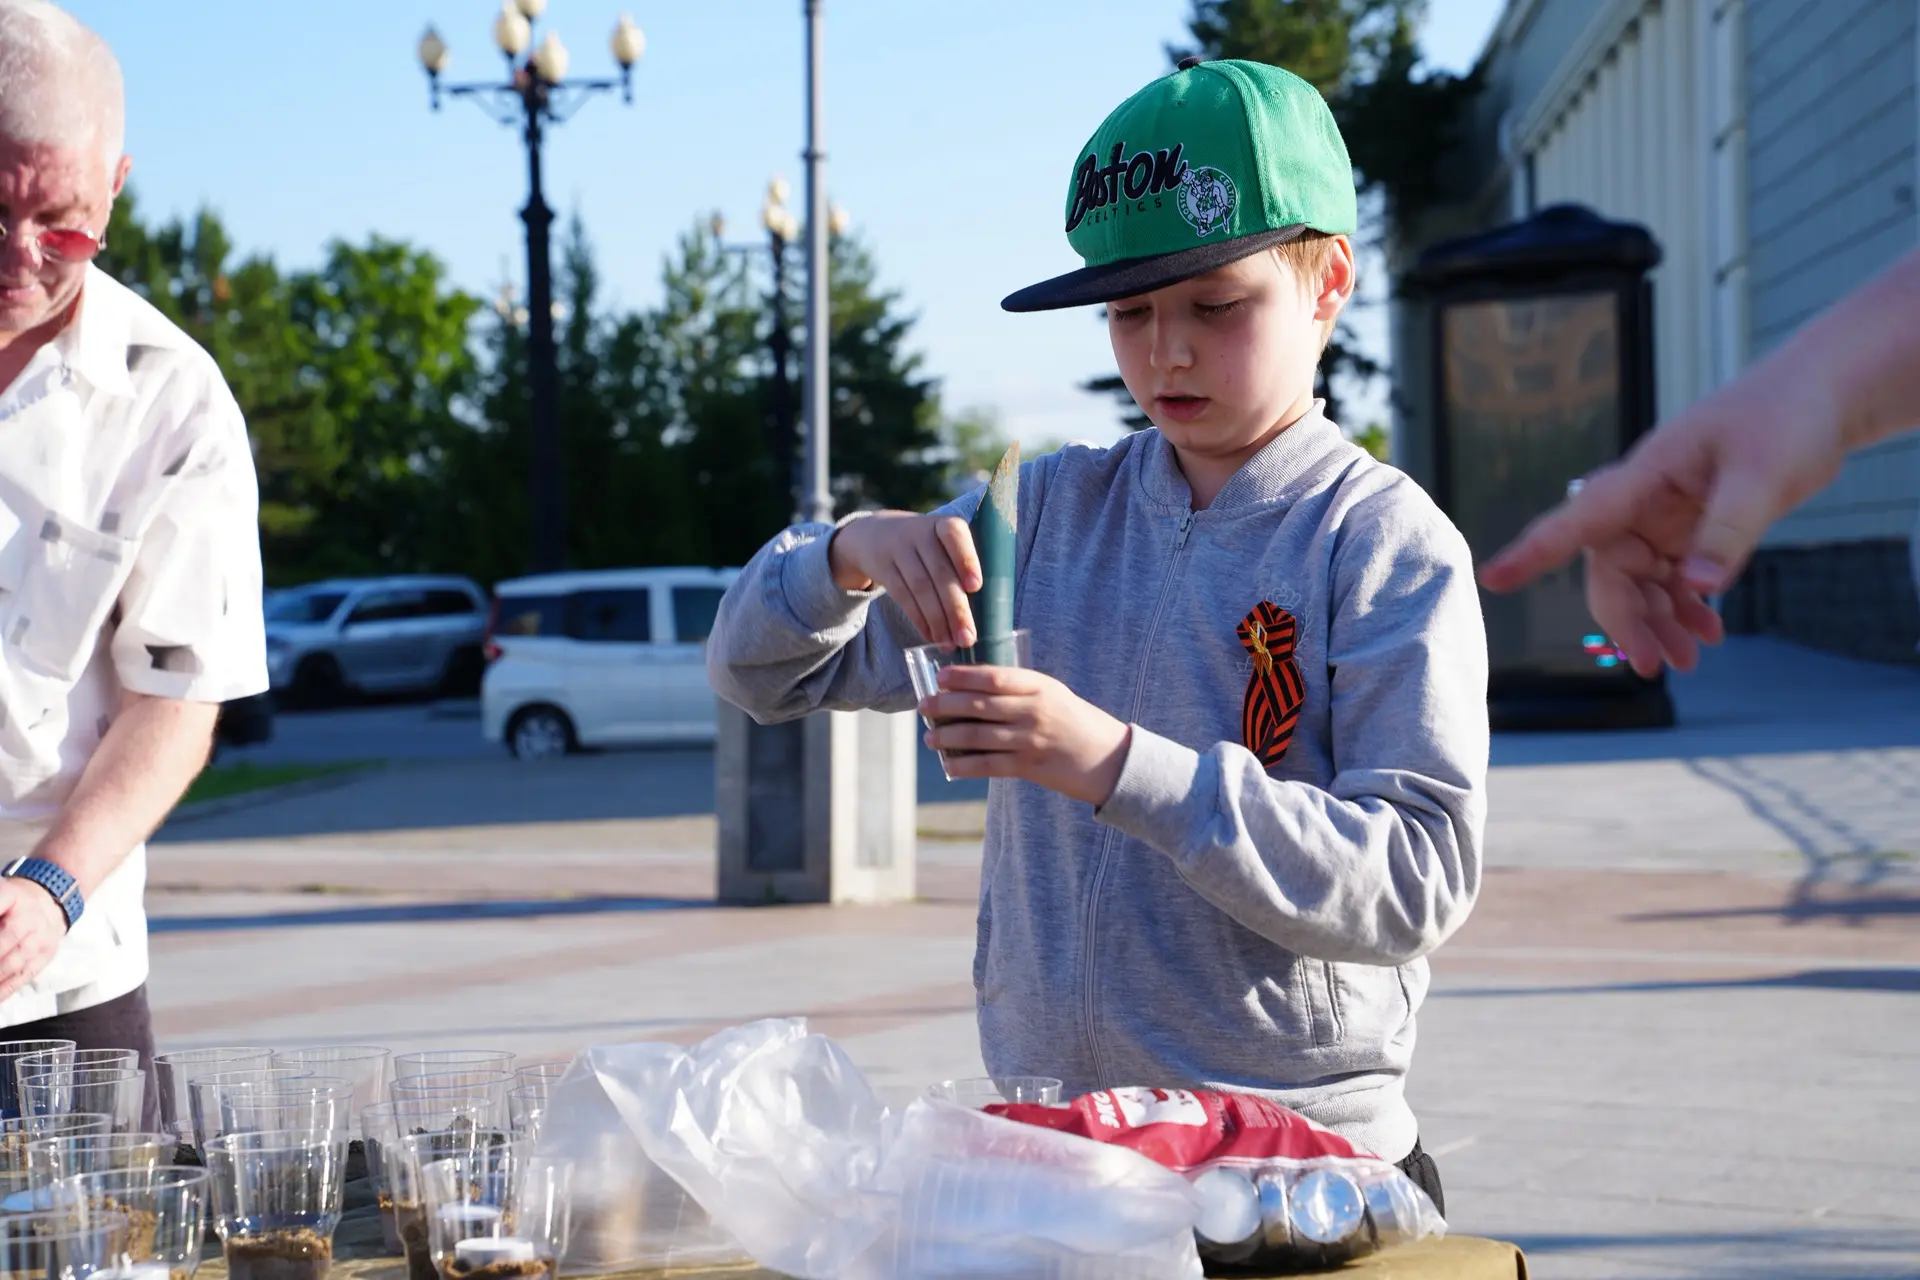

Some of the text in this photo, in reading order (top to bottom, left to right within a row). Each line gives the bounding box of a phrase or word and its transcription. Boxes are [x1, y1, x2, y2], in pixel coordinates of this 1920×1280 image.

[1065, 141, 1188, 233] Boston
[1179, 184, 1194, 221] BOSTON
[1086, 197, 1162, 226] CELTICS
